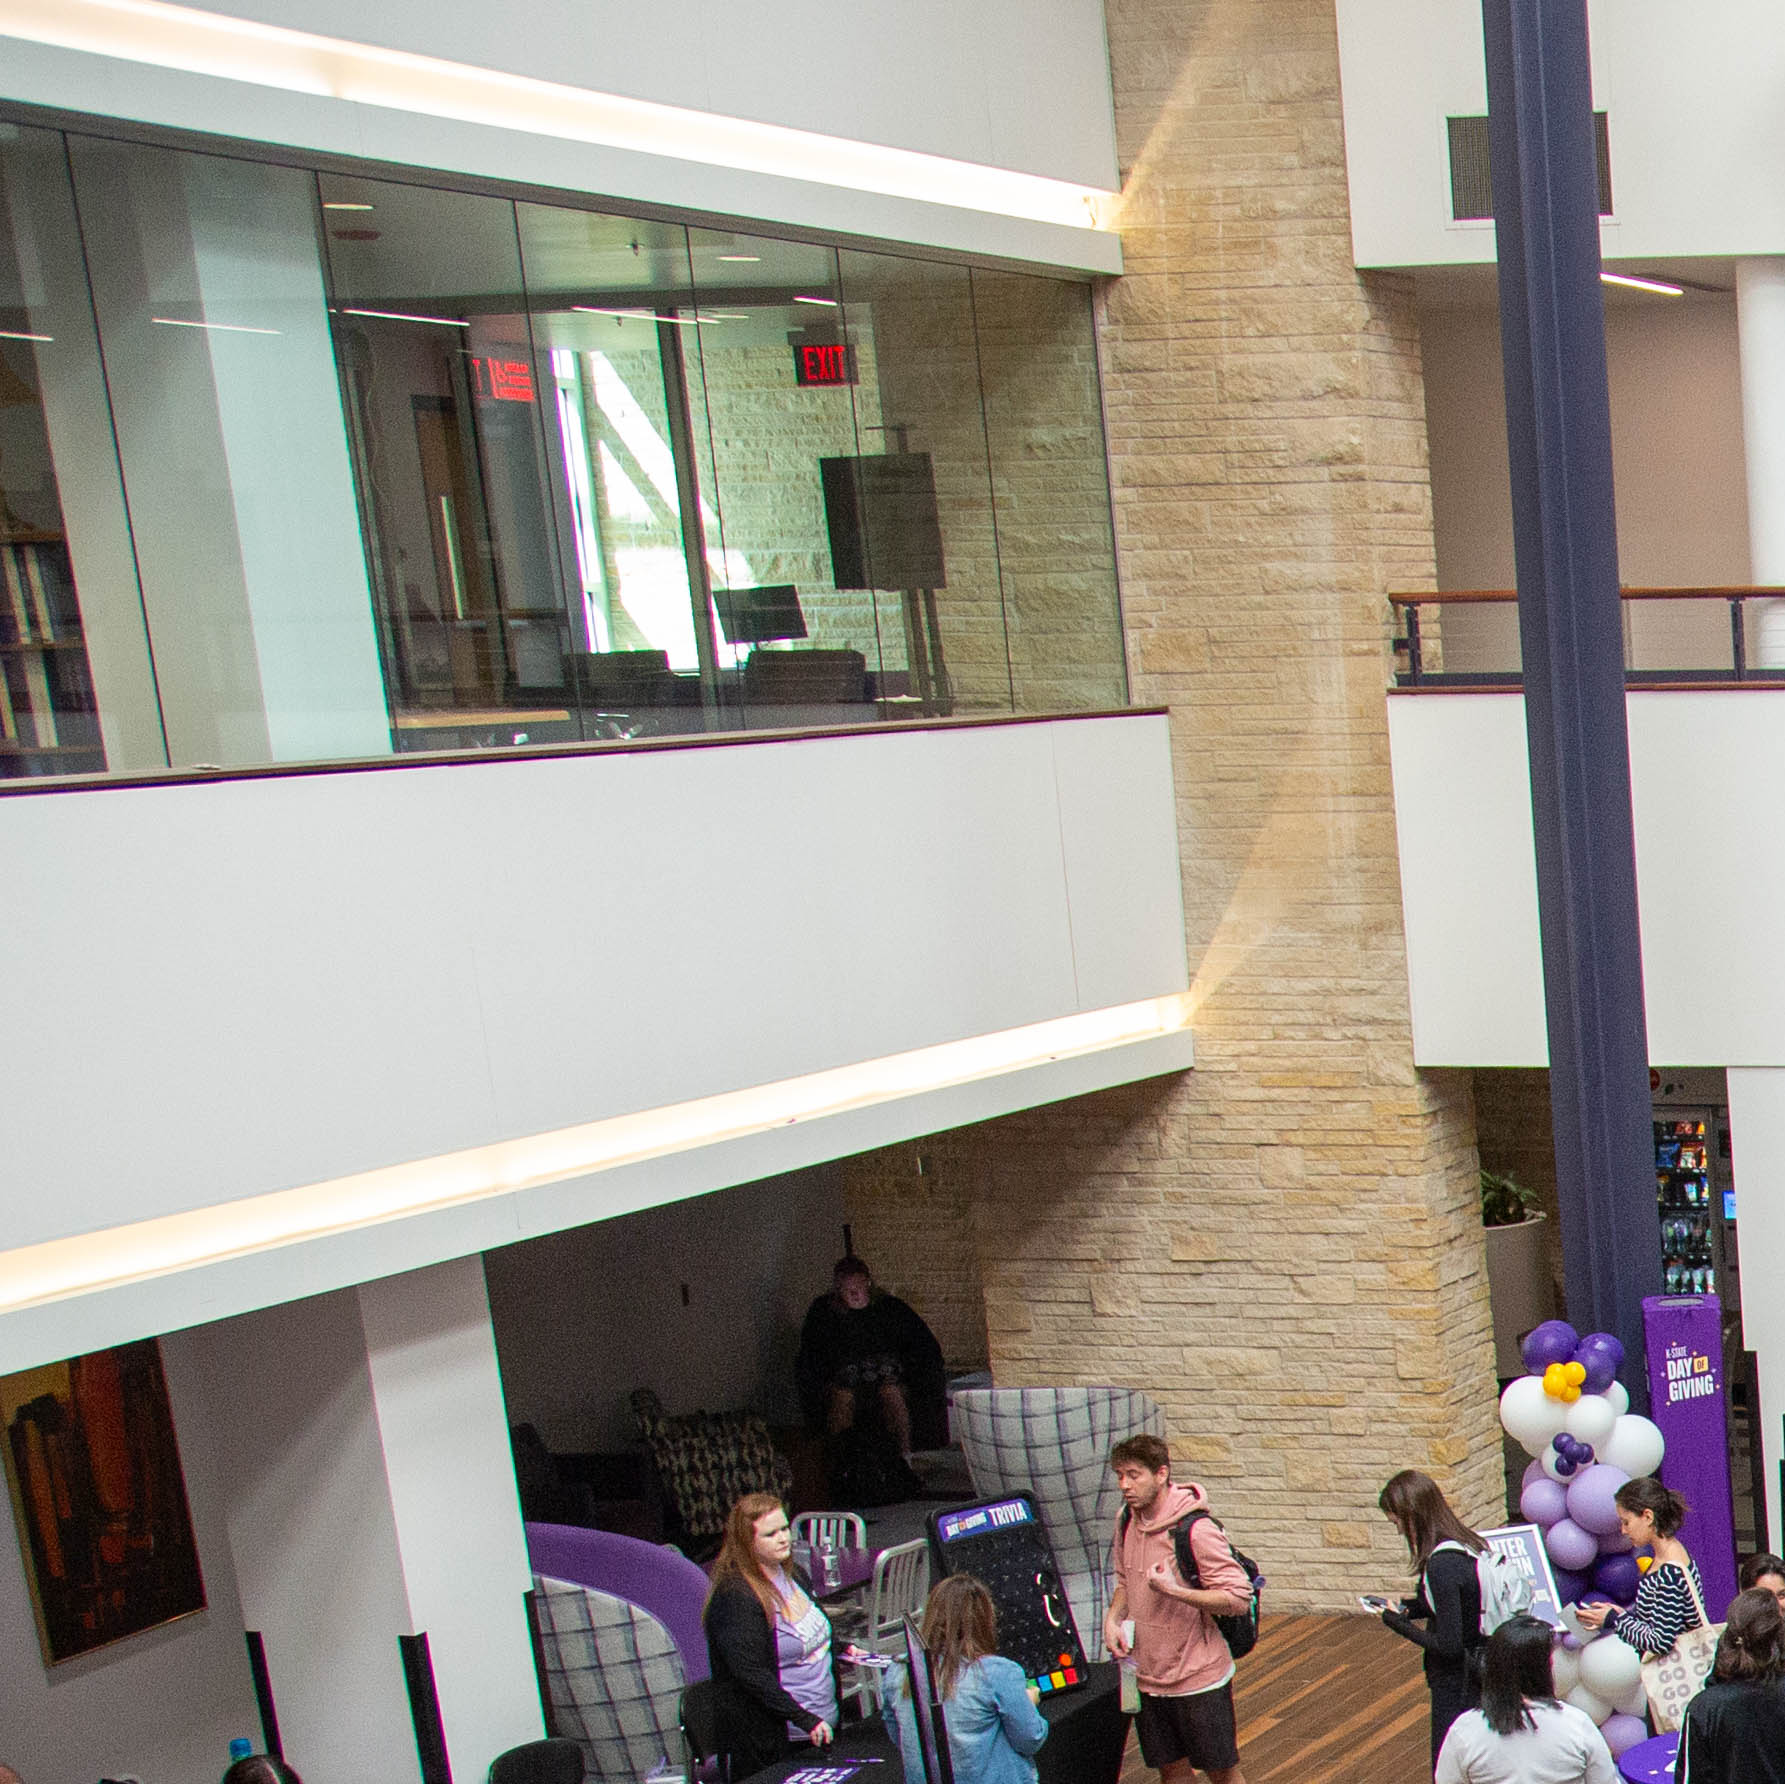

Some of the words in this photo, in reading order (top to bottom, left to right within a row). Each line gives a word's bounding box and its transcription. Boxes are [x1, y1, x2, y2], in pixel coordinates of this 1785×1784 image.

[802, 346, 845, 381] EXIT
[1667, 1358, 1693, 1380] DAY
[1669, 1375, 1714, 1402] GIVING
[988, 1502, 1027, 1527] TRIVIA
[1488, 1536, 1529, 1559] NTER
[1658, 1666, 1686, 1685] GO
[1662, 1683, 1691, 1701] GO
